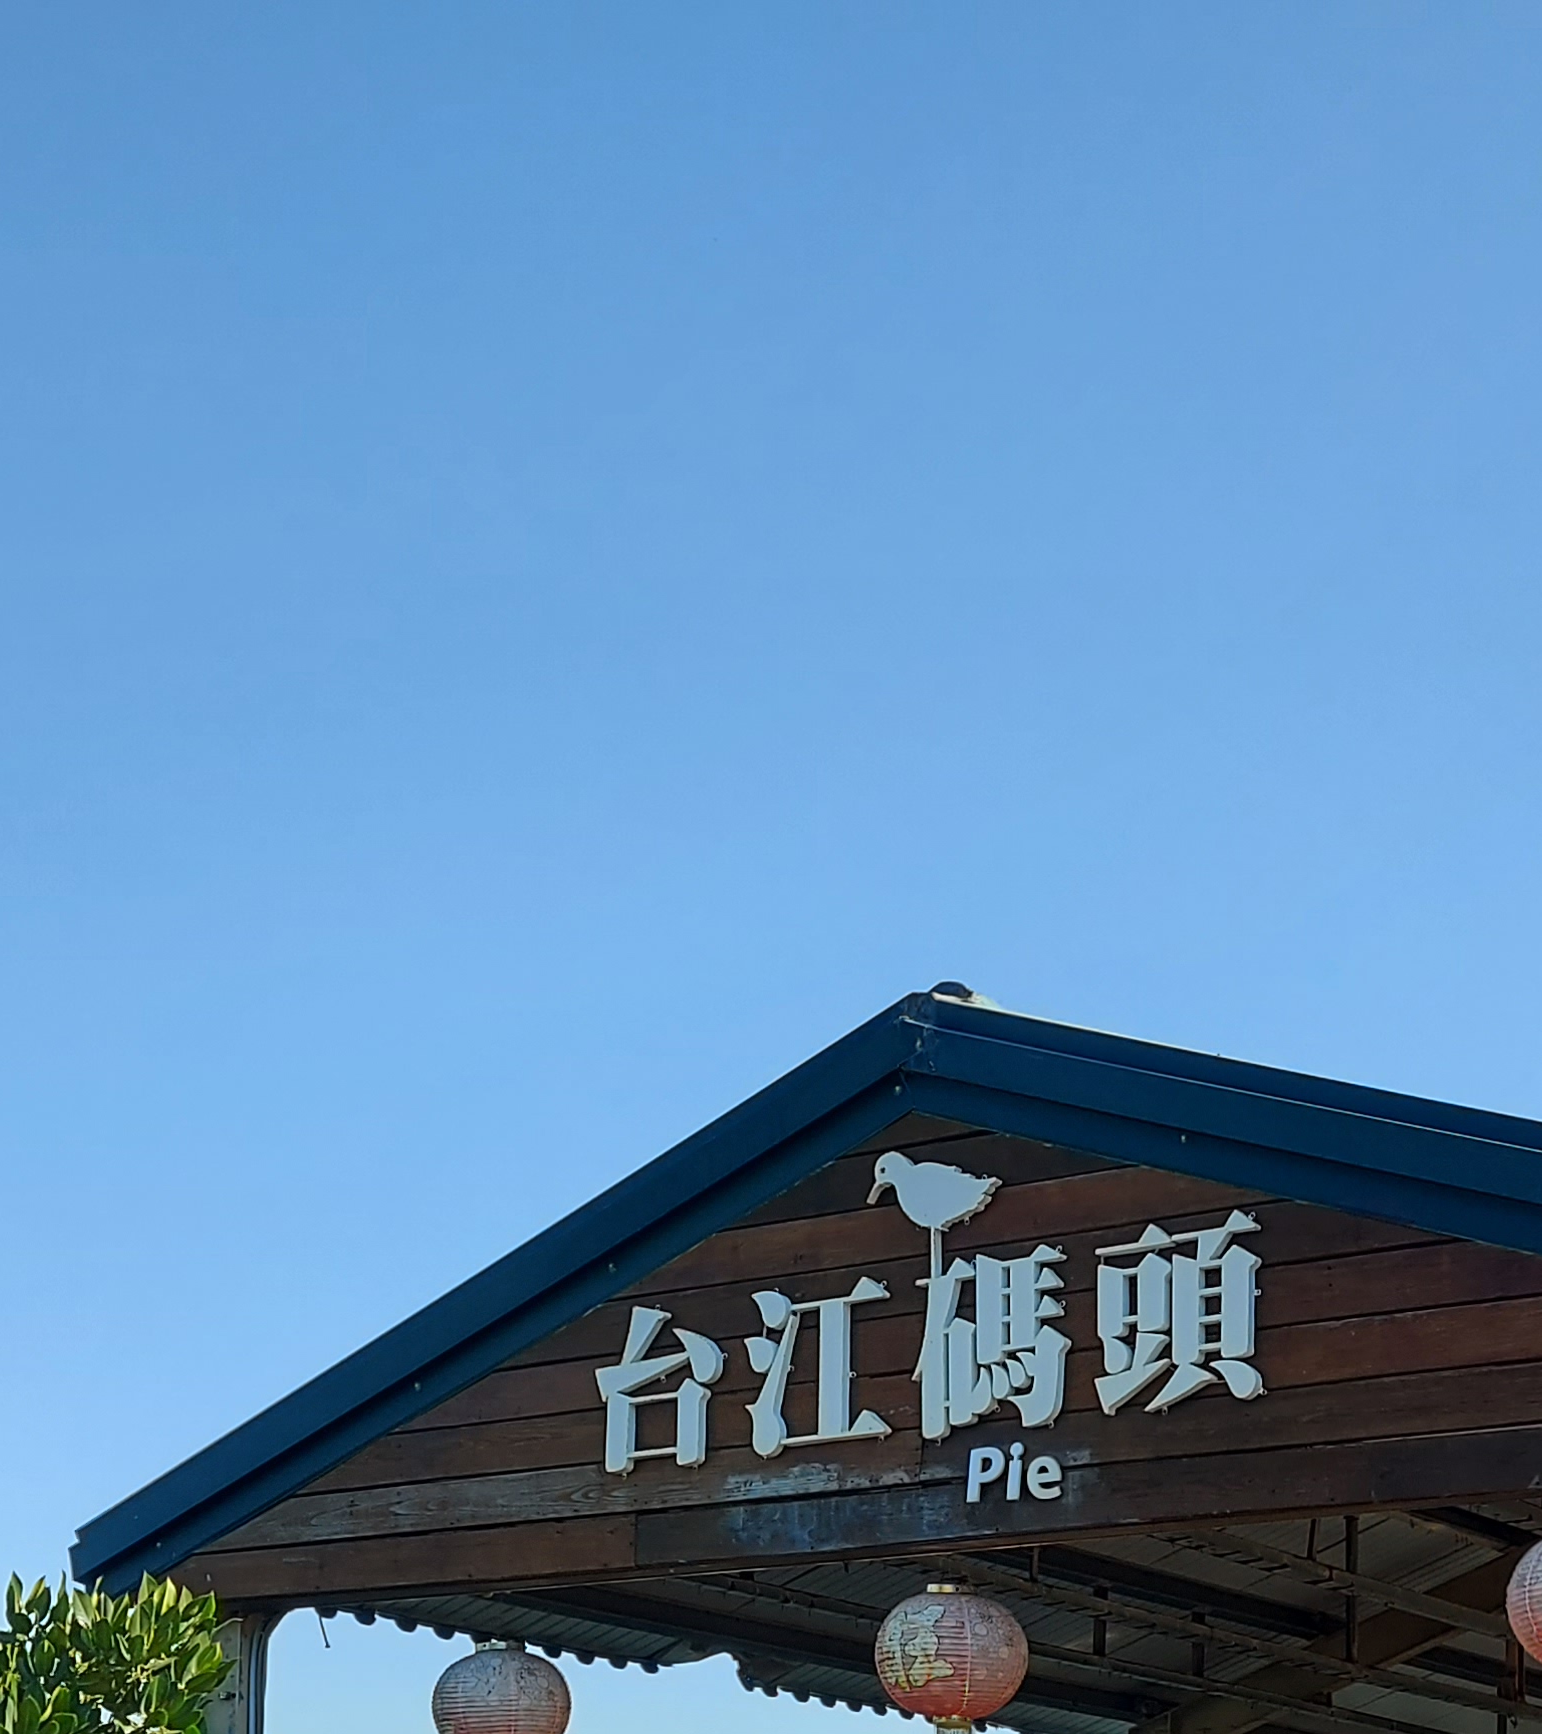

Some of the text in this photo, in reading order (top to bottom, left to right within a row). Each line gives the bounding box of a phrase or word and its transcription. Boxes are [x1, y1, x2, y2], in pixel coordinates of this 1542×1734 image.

[595, 1209, 1265, 1476] 台江碼頭
[966, 1442, 1063, 1504] Pie
